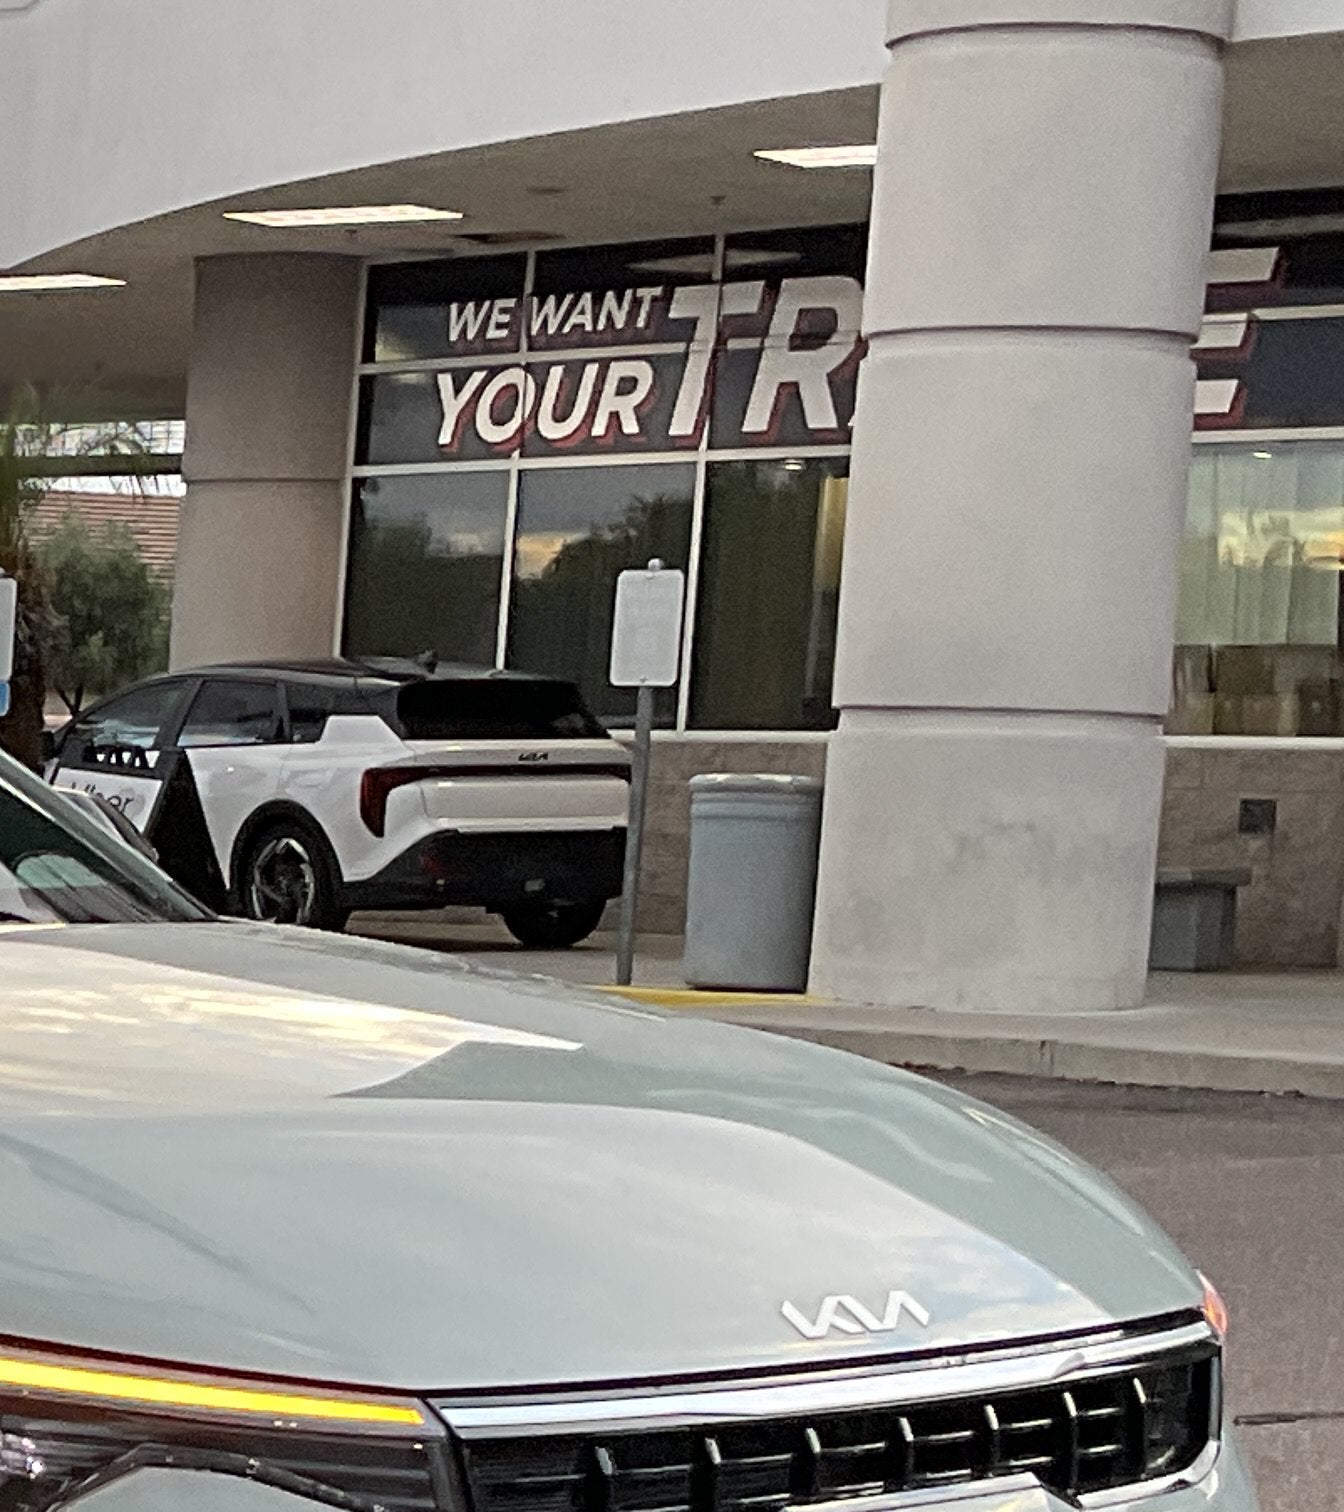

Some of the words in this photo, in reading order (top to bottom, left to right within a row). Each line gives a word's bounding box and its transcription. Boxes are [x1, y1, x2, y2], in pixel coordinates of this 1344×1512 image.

[447, 298, 518, 342] WE
[529, 286, 663, 336] WANT
[436, 360, 654, 446] YOUR
[781, 1290, 930, 1339] KIA
